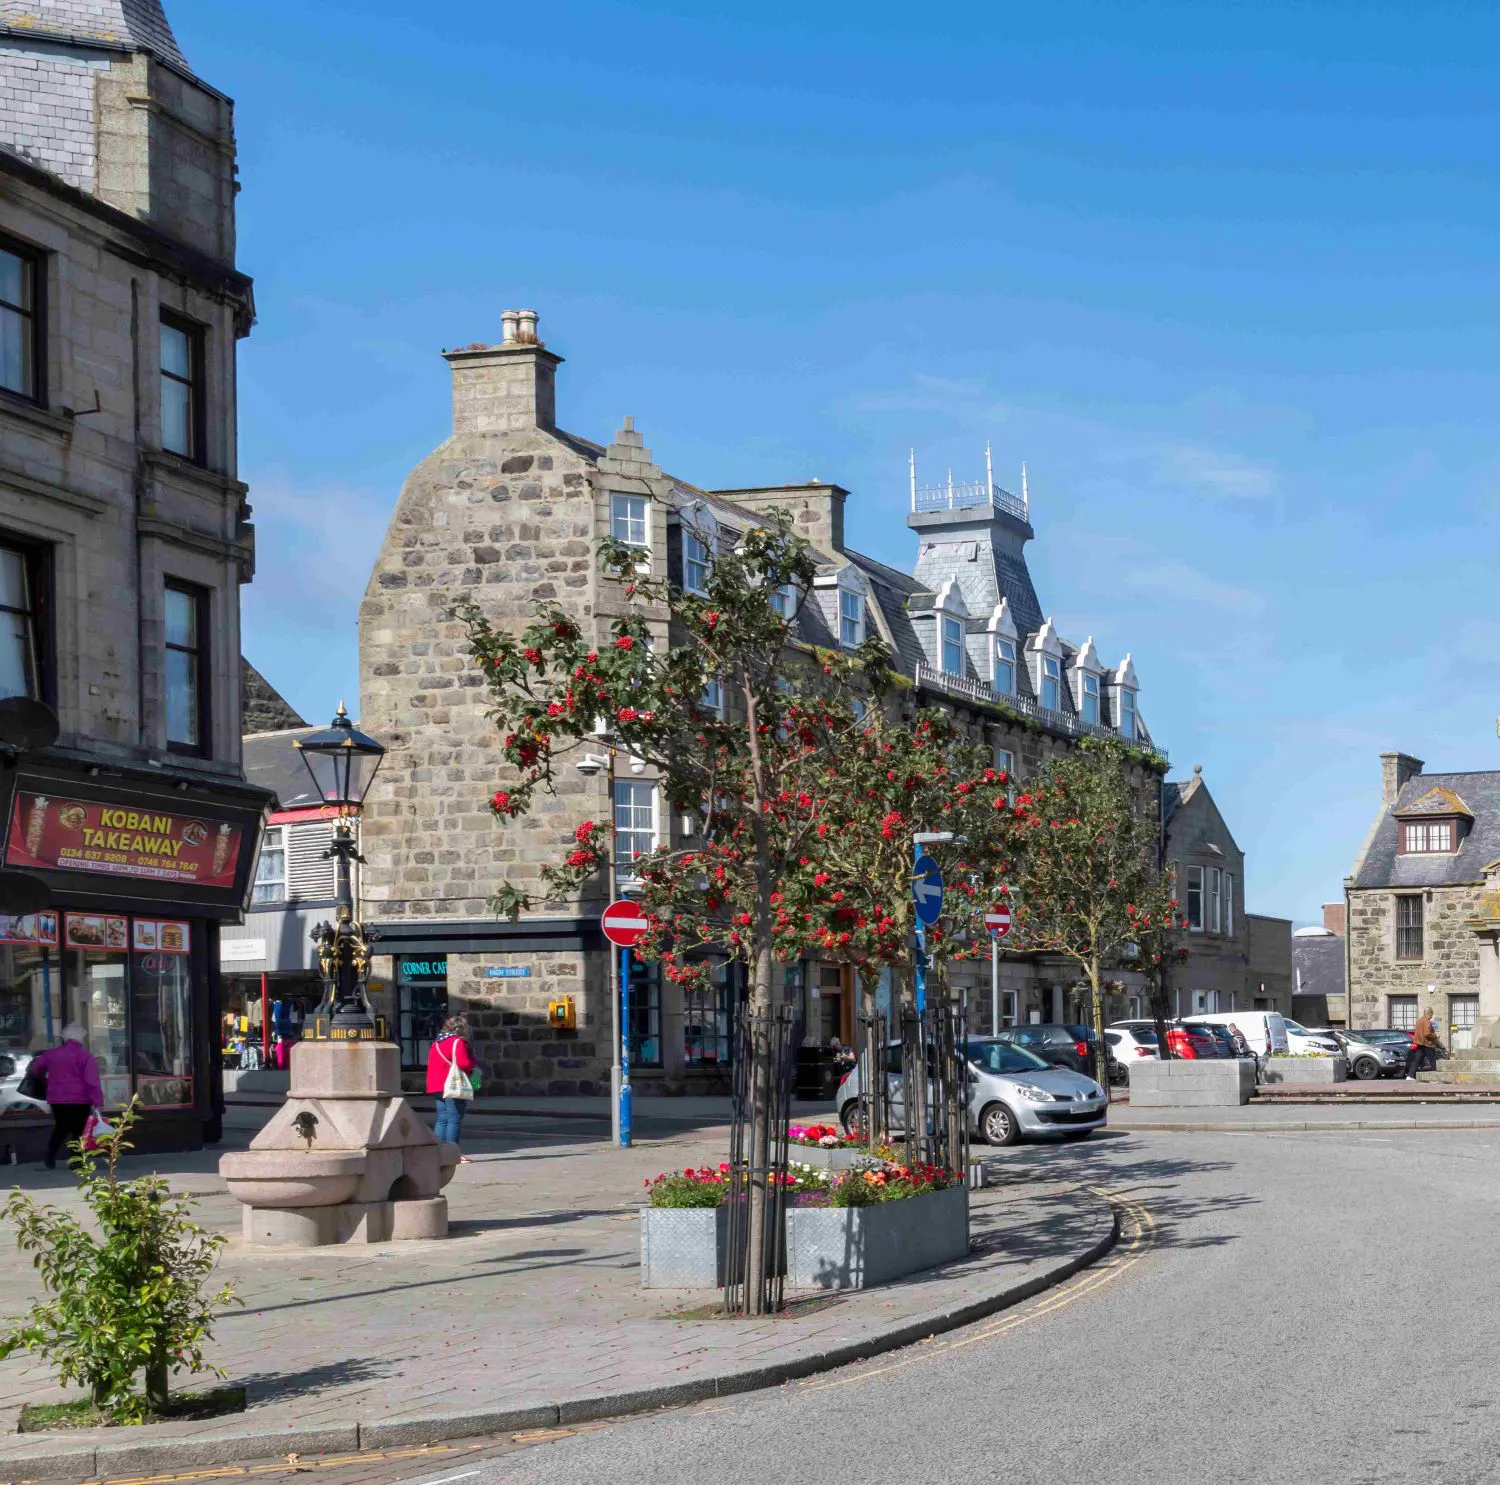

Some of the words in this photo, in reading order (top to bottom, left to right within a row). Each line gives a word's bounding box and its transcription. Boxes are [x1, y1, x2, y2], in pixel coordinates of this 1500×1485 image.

[100, 808, 172, 835] KOBANI
[82, 828, 184, 857] TAKEAWAY
[401, 961, 431, 975] CORNER
[432, 961, 448, 974] CAF
